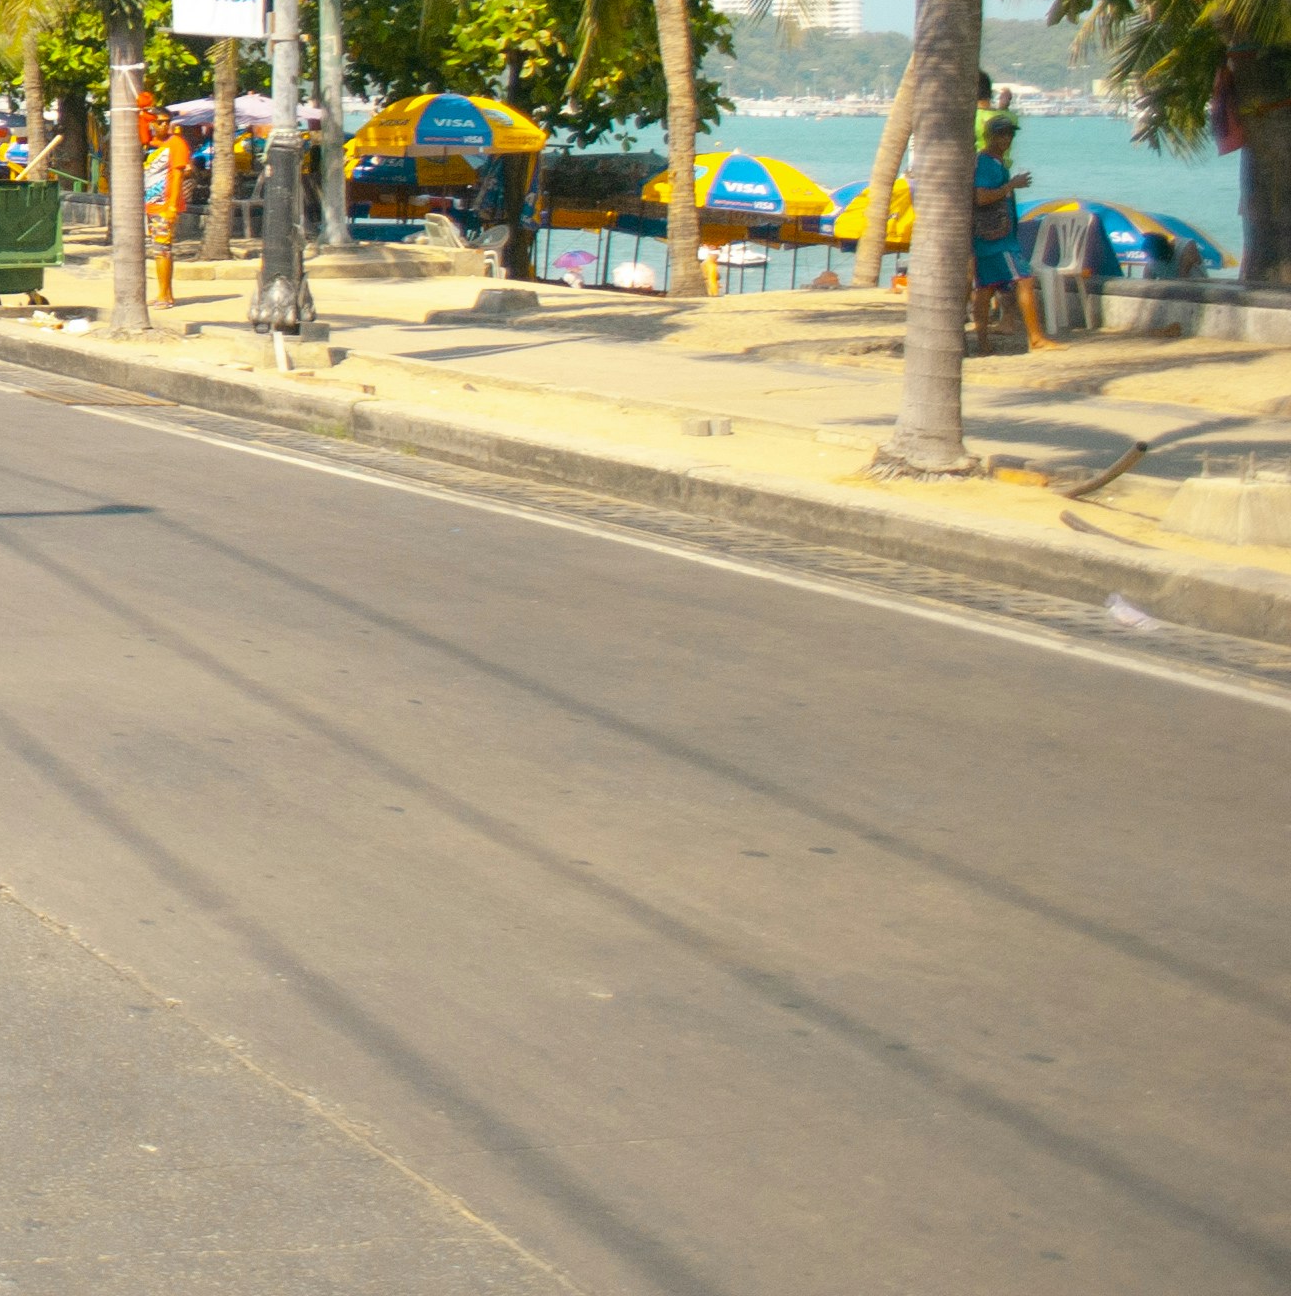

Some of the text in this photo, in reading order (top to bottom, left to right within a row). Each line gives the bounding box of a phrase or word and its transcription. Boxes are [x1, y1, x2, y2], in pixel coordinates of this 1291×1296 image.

[433, 117, 476, 128] VISA
[722, 181, 767, 195] VISA
[1108, 231, 1136, 243] SA
